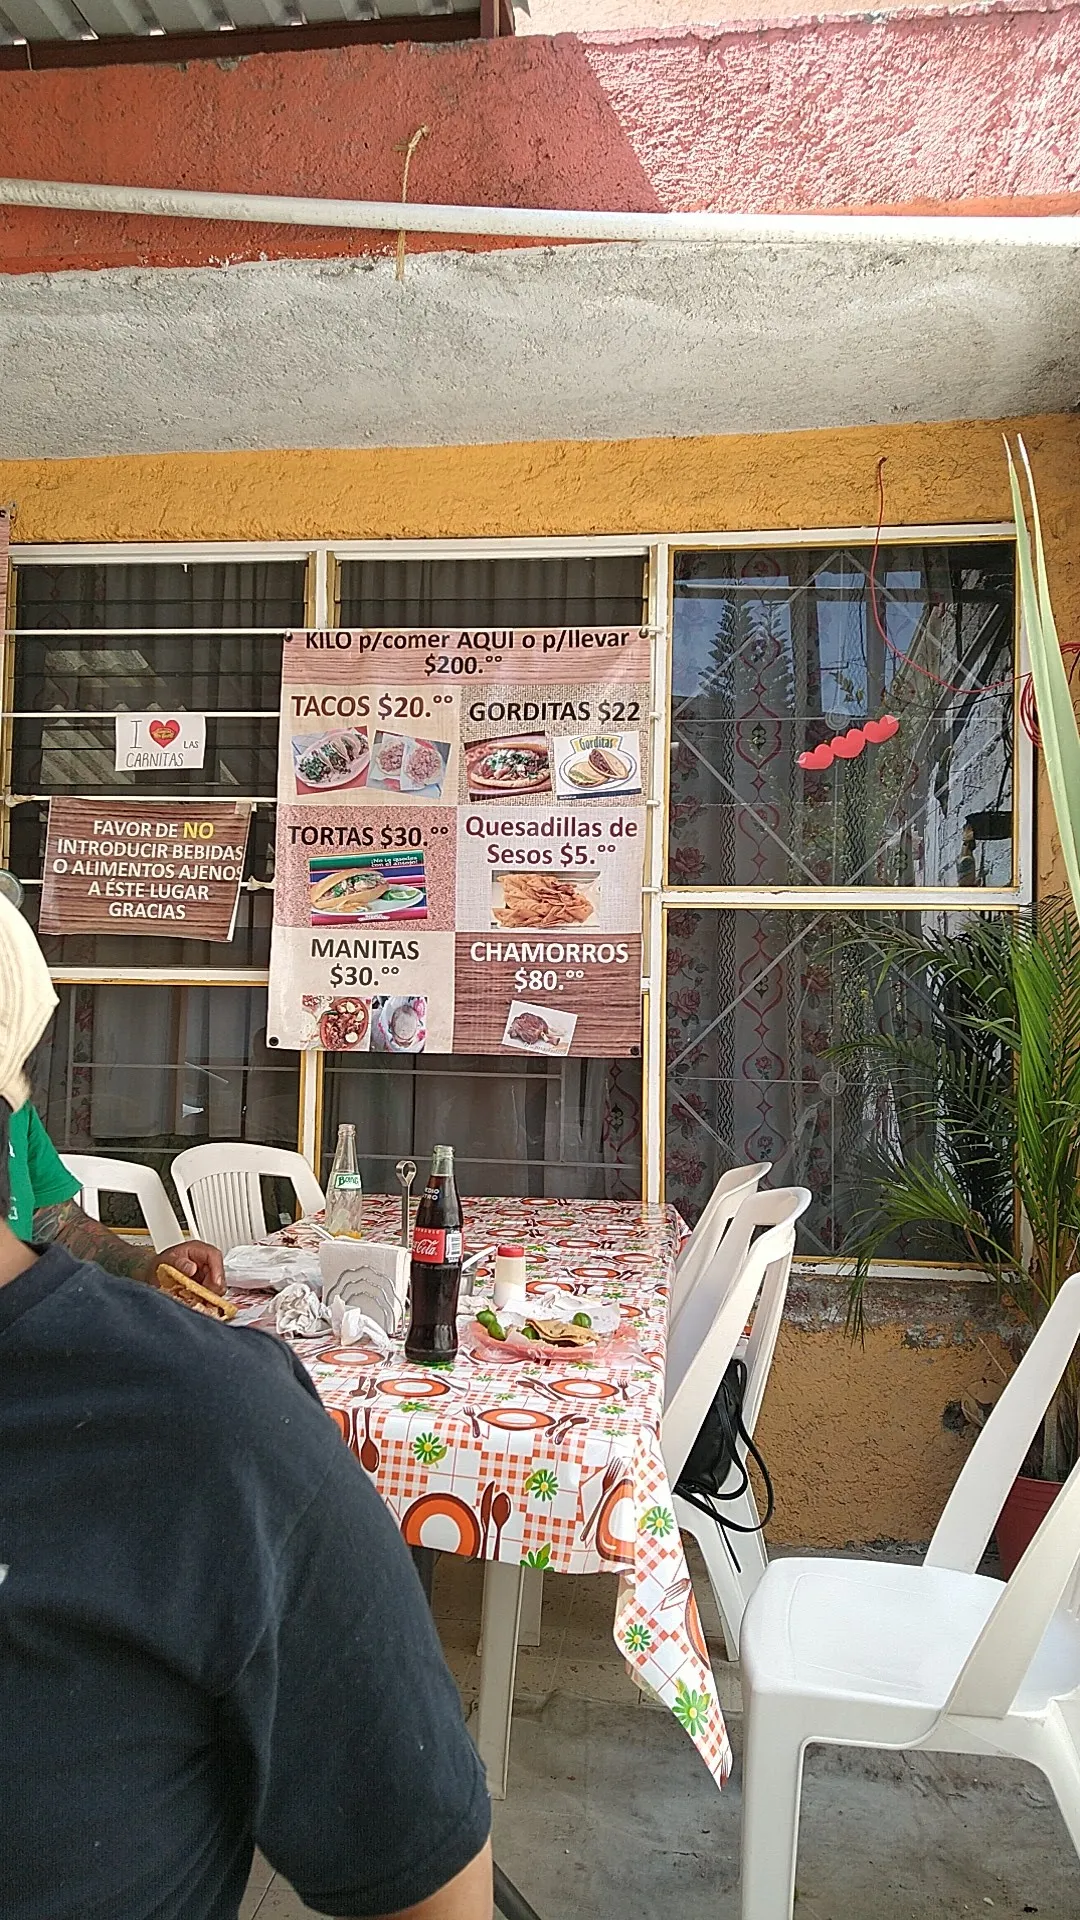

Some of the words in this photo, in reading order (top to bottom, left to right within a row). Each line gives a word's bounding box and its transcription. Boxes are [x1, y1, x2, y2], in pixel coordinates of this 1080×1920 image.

[306, 631, 351, 650] KILO
[359, 631, 450, 653] p/comer
[457, 630, 514, 651] AQUI
[522, 634, 536, 649] o
[543, 629, 630, 652] p/llevar
[291, 695, 370, 718] TACOS
[469, 701, 590, 722] GORDITAS
[599, 699, 640, 724] $22
[130, 720, 142, 749] I
[183, 740, 199, 749] LAS
[579, 736, 614, 750] Gorditas
[126, 752, 184, 768] CARNITAS
[93, 820, 151, 838] FAVOR
[155, 822, 178, 838] DE
[183, 821, 214, 839] NO
[288, 826, 374, 848] TORTAS
[465, 816, 601, 837] Quesadillas
[609, 817, 638, 838] de
[57, 839, 168, 859] INTRODUCIR
[172, 844, 244, 861] BEBIDAS
[487, 843, 553, 865] Sesos
[53, 858, 68, 874] O
[72, 860, 175, 879] ALIMENTOS
[179, 865, 243, 881] AJENOS
[88, 881, 101, 896] A
[105, 878, 145, 898] ÉSTE
[150, 883, 209, 900] LUGAR
[108, 901, 186, 920] GRACIAS
[311, 938, 420, 960] MANITAS
[470, 941, 628, 963] CHAMORROS
